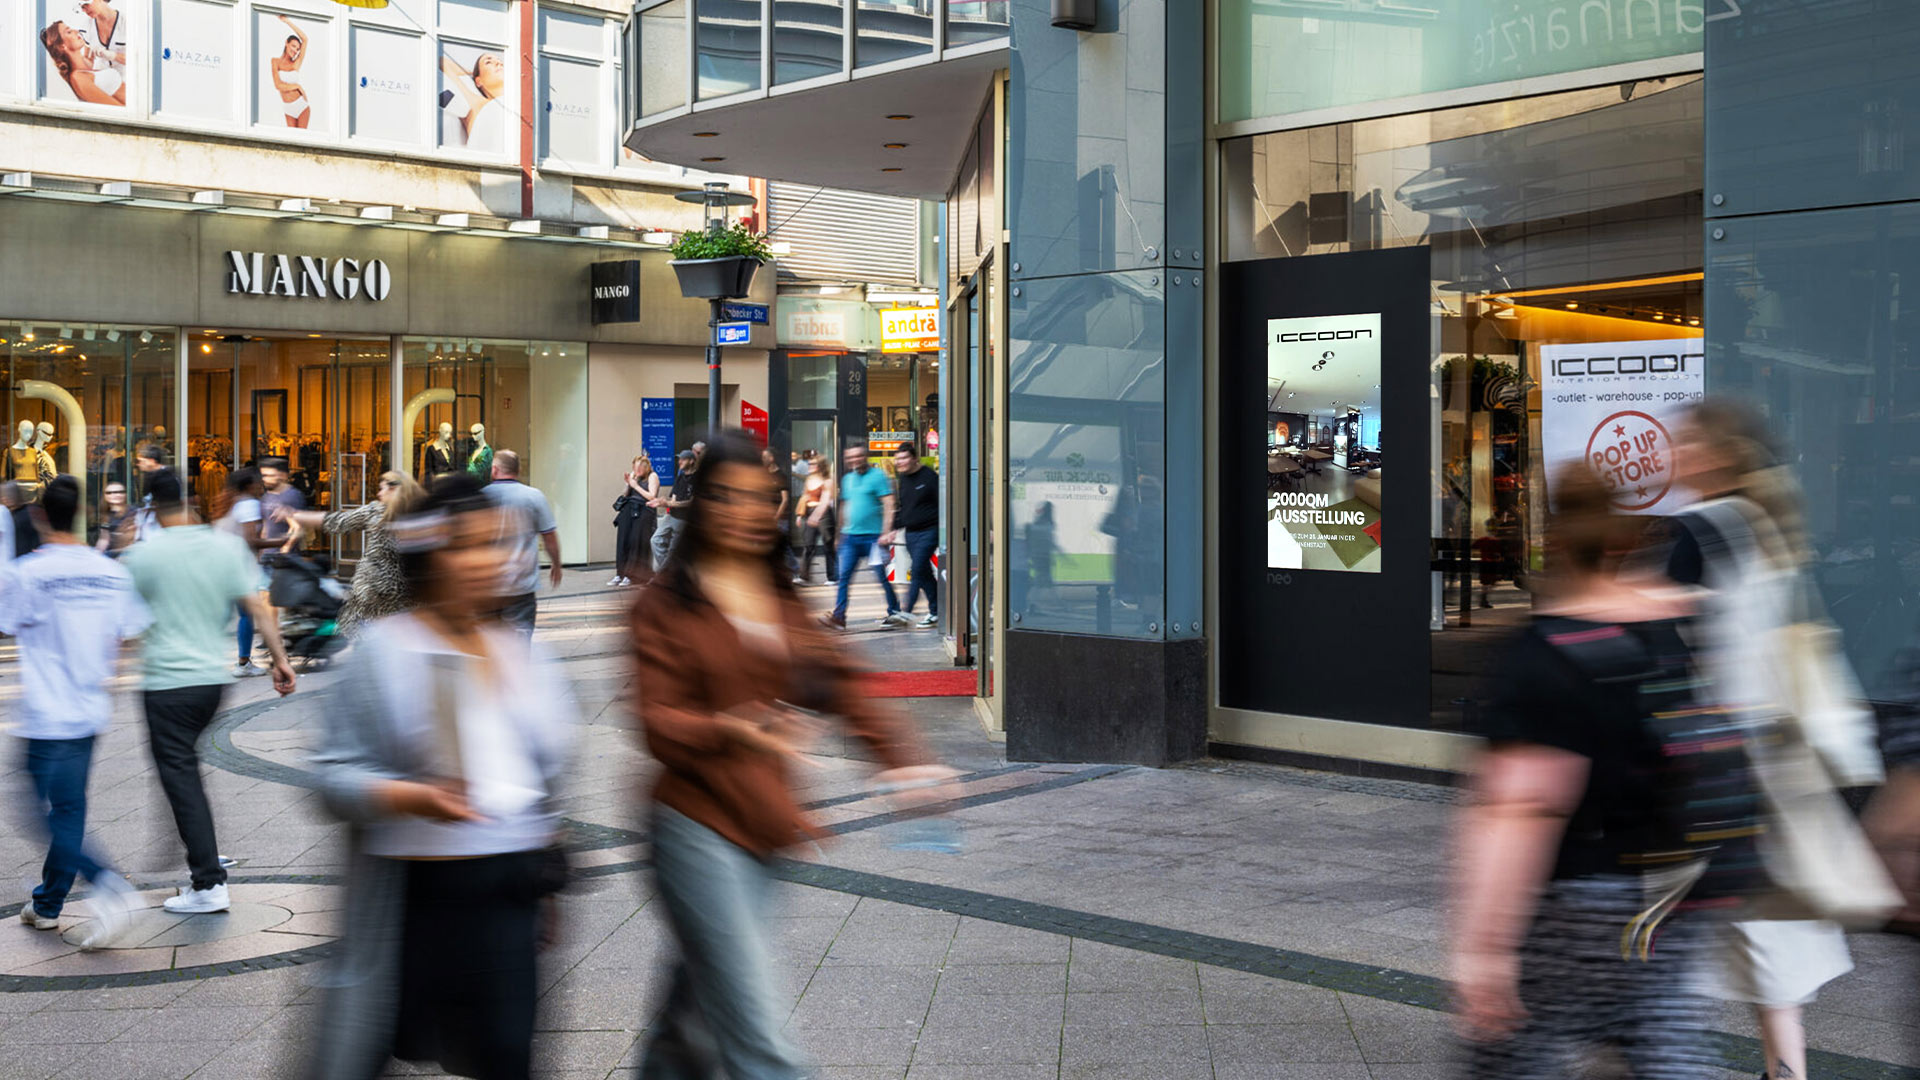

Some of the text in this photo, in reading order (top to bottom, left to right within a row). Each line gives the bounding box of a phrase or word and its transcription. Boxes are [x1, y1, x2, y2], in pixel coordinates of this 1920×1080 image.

[175, 50, 221, 64] NAZAR
[371, 79, 410, 91] NAZAR
[228, 250, 391, 301] MANGO
[594, 285, 630, 299] MANGO
[887, 313, 937, 334] andrä
[849, 371, 861, 382] 20
[1551, 376, 1621, 384] INTERIOR
[849, 384, 861, 395] 28
[1596, 391, 1653, 402] warehouse
[1593, 430, 1657, 472] POP UP
[1604, 451, 1665, 489] STORE
[1273, 492, 1329, 508] 2000QM
[1273, 509, 1365, 526] AUSSTELLUNG
